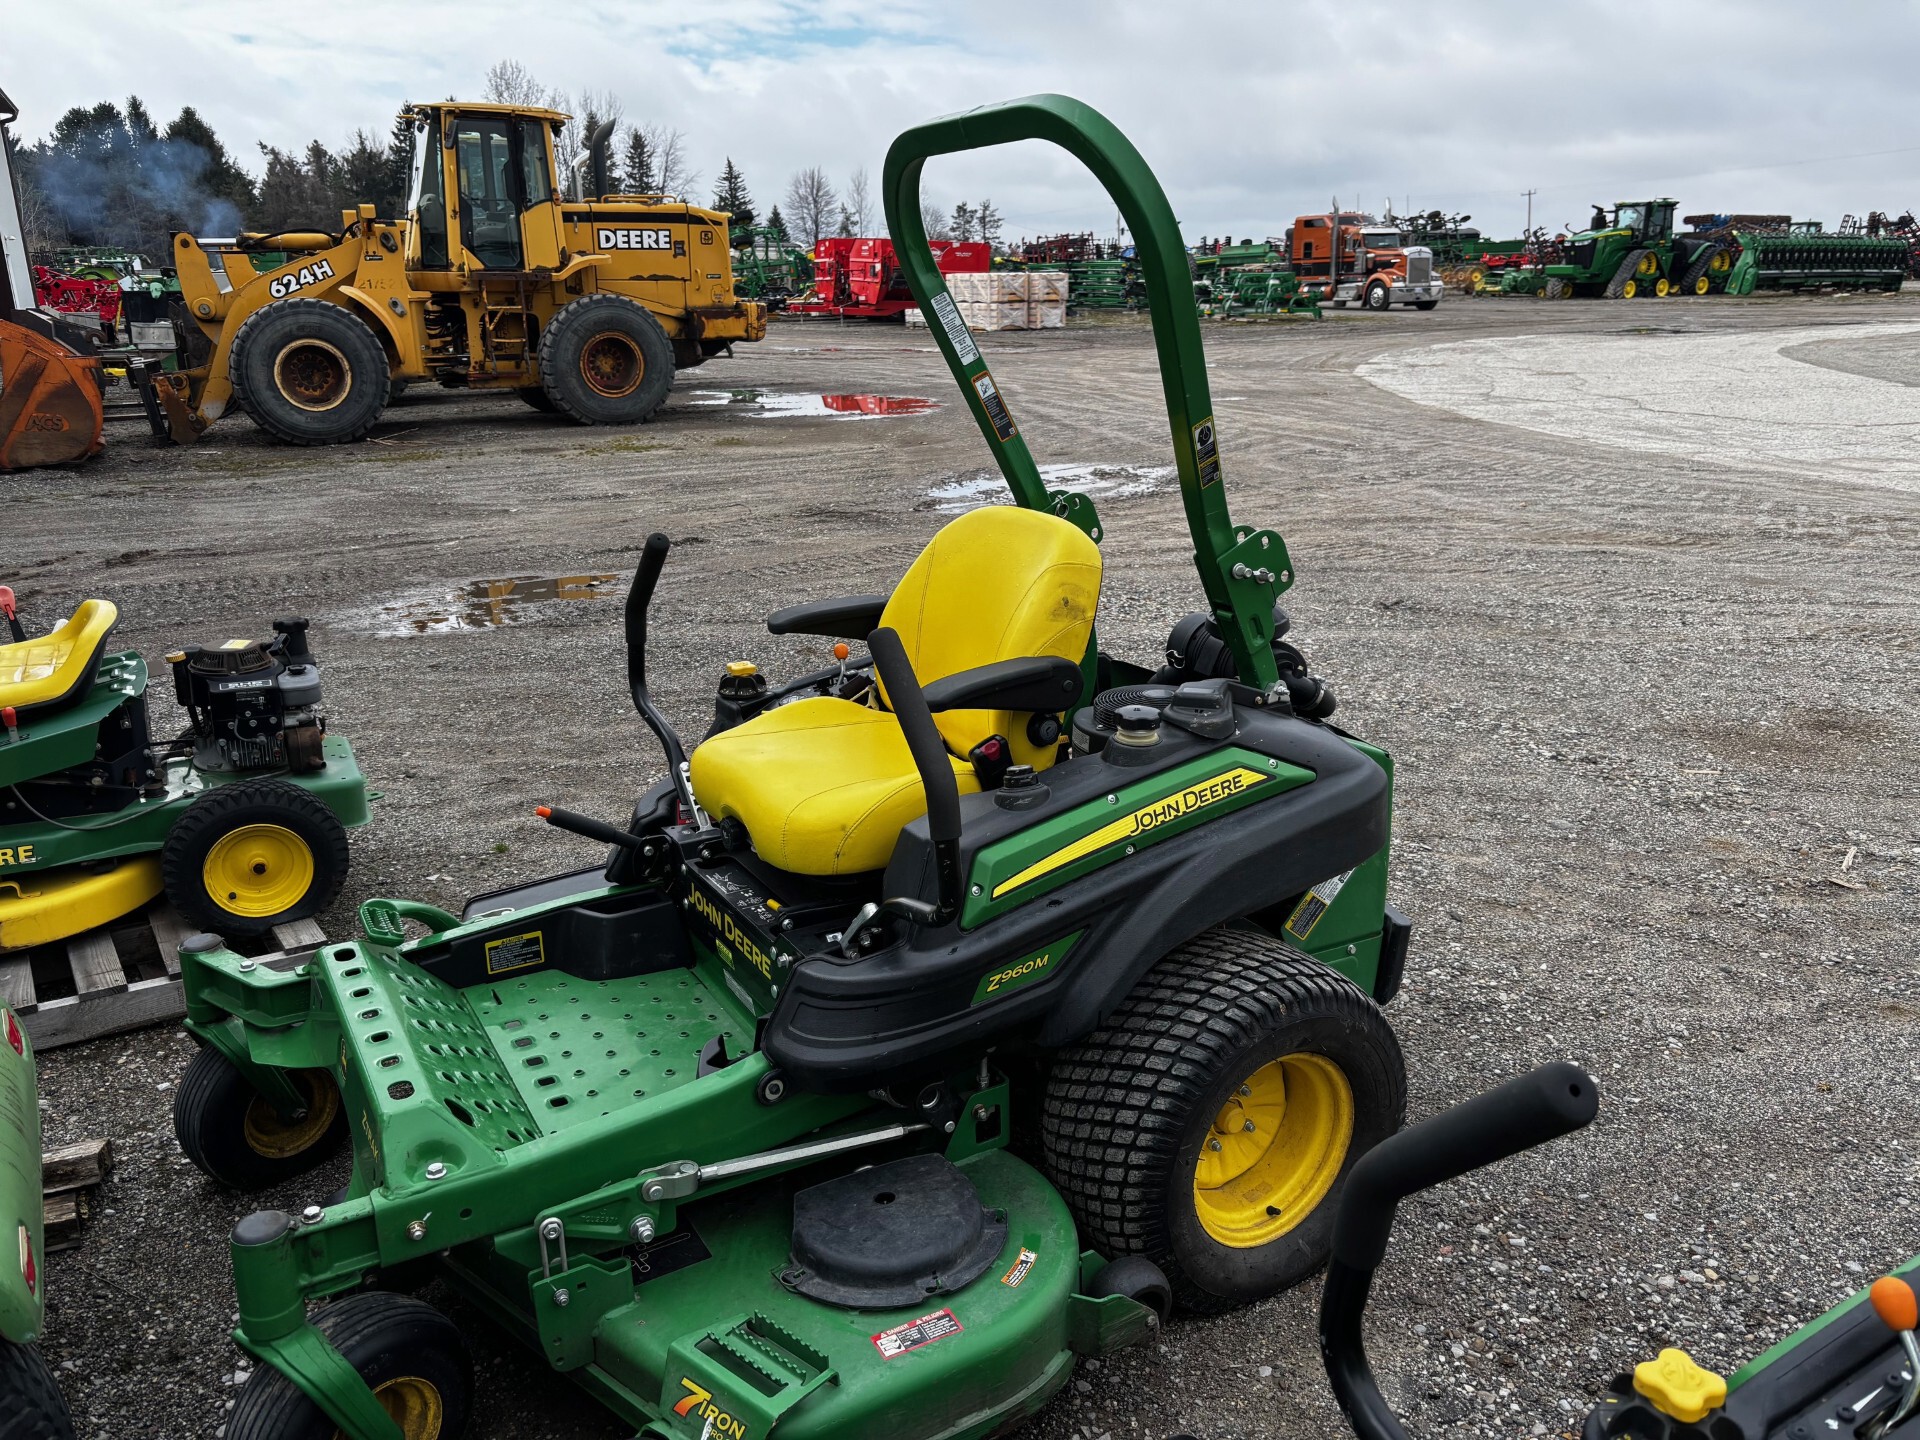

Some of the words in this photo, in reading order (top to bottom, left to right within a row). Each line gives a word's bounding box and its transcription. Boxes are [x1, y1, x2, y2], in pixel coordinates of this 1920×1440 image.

[598, 229, 671, 249] DEERE
[269, 258, 335, 299] 624H
[1130, 800, 1181, 835] JOHN
[1183, 774, 1245, 812] DEERE
[688, 882, 722, 930] JOHN
[724, 914, 771, 980] DEERE
[986, 954, 1049, 992] Z960M
